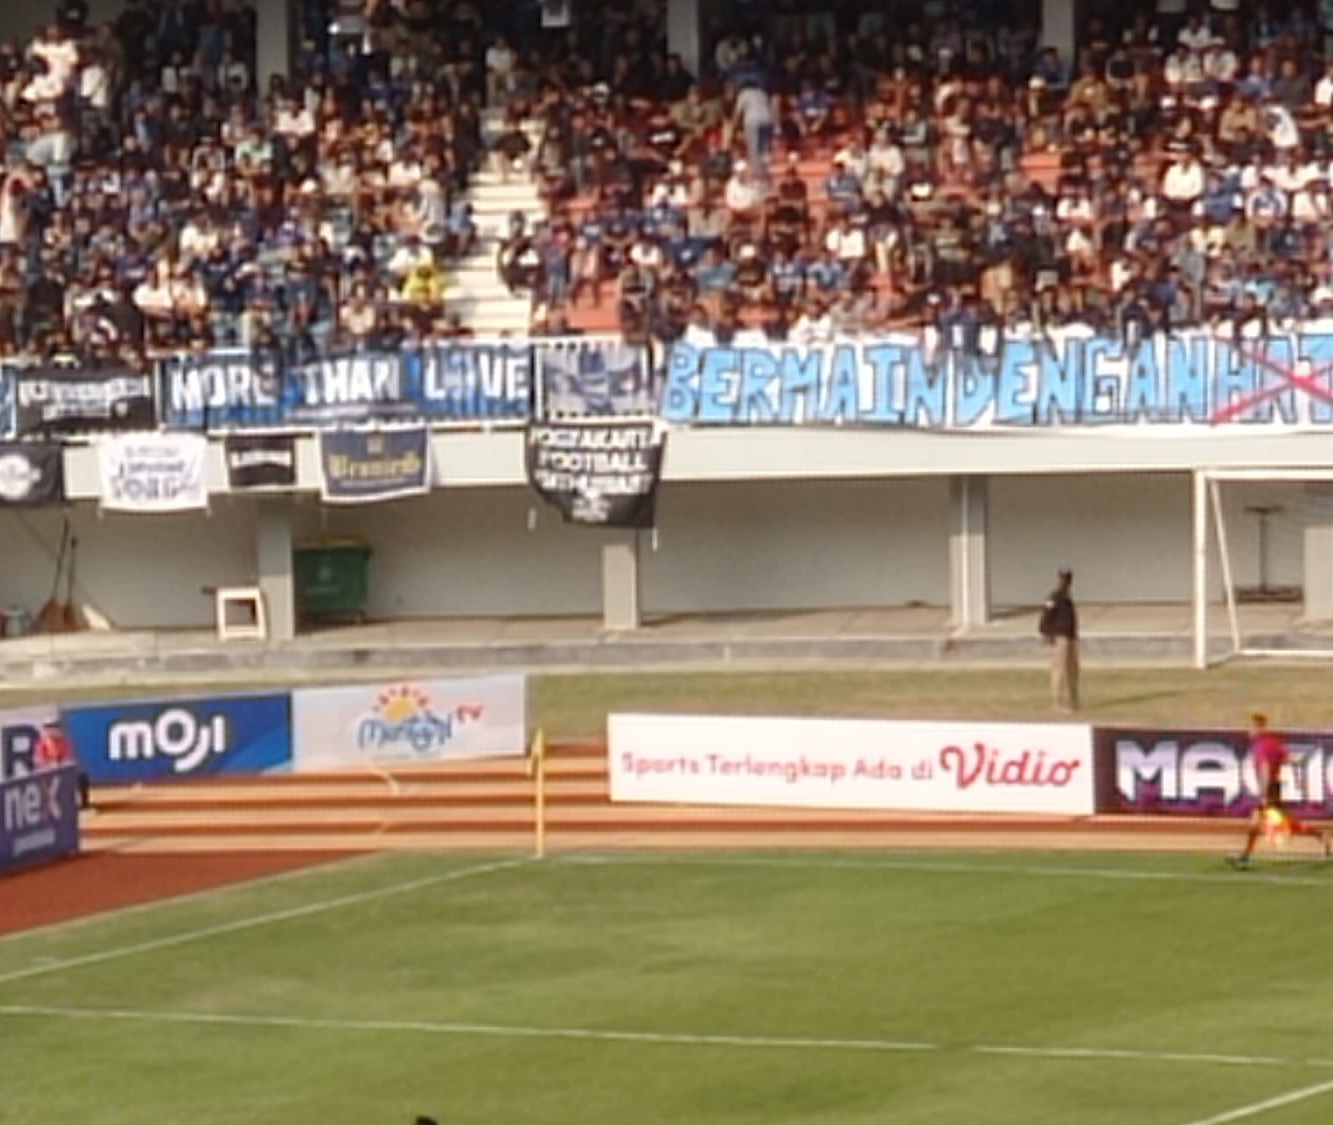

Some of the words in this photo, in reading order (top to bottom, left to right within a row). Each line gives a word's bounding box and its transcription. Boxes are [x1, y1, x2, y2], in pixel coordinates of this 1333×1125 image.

[300, 357, 400, 405] THAN
[621, 751, 701, 779] Sports
[708, 753, 845, 785] Terlengkap
[852, 757, 903, 781] Ada
[910, 758, 934, 781] di
[938, 742, 1081, 790] Vidio
